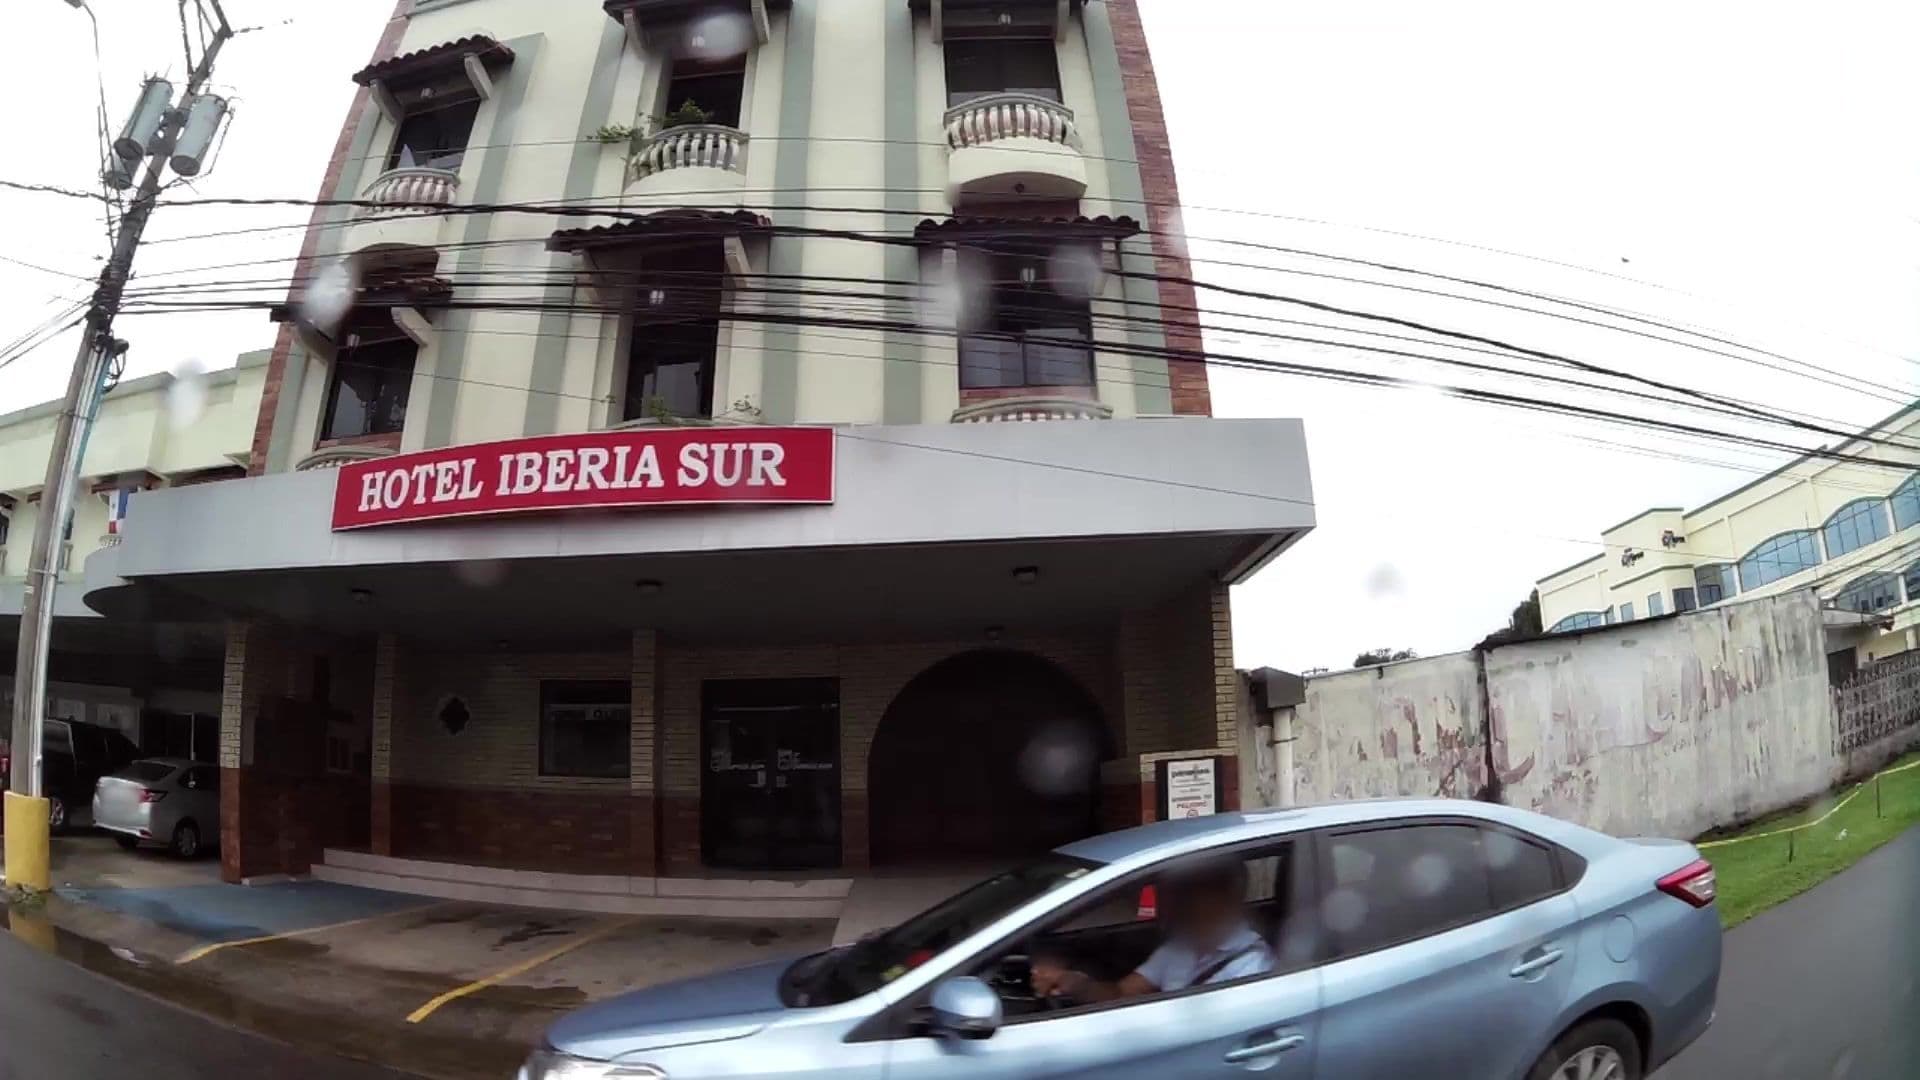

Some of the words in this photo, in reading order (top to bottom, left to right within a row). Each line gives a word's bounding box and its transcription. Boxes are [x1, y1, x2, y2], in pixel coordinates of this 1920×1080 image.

[358, 458, 484, 512] HOTEL
[496, 445, 665, 496] IBERIA
[677, 442, 786, 487] SUR
